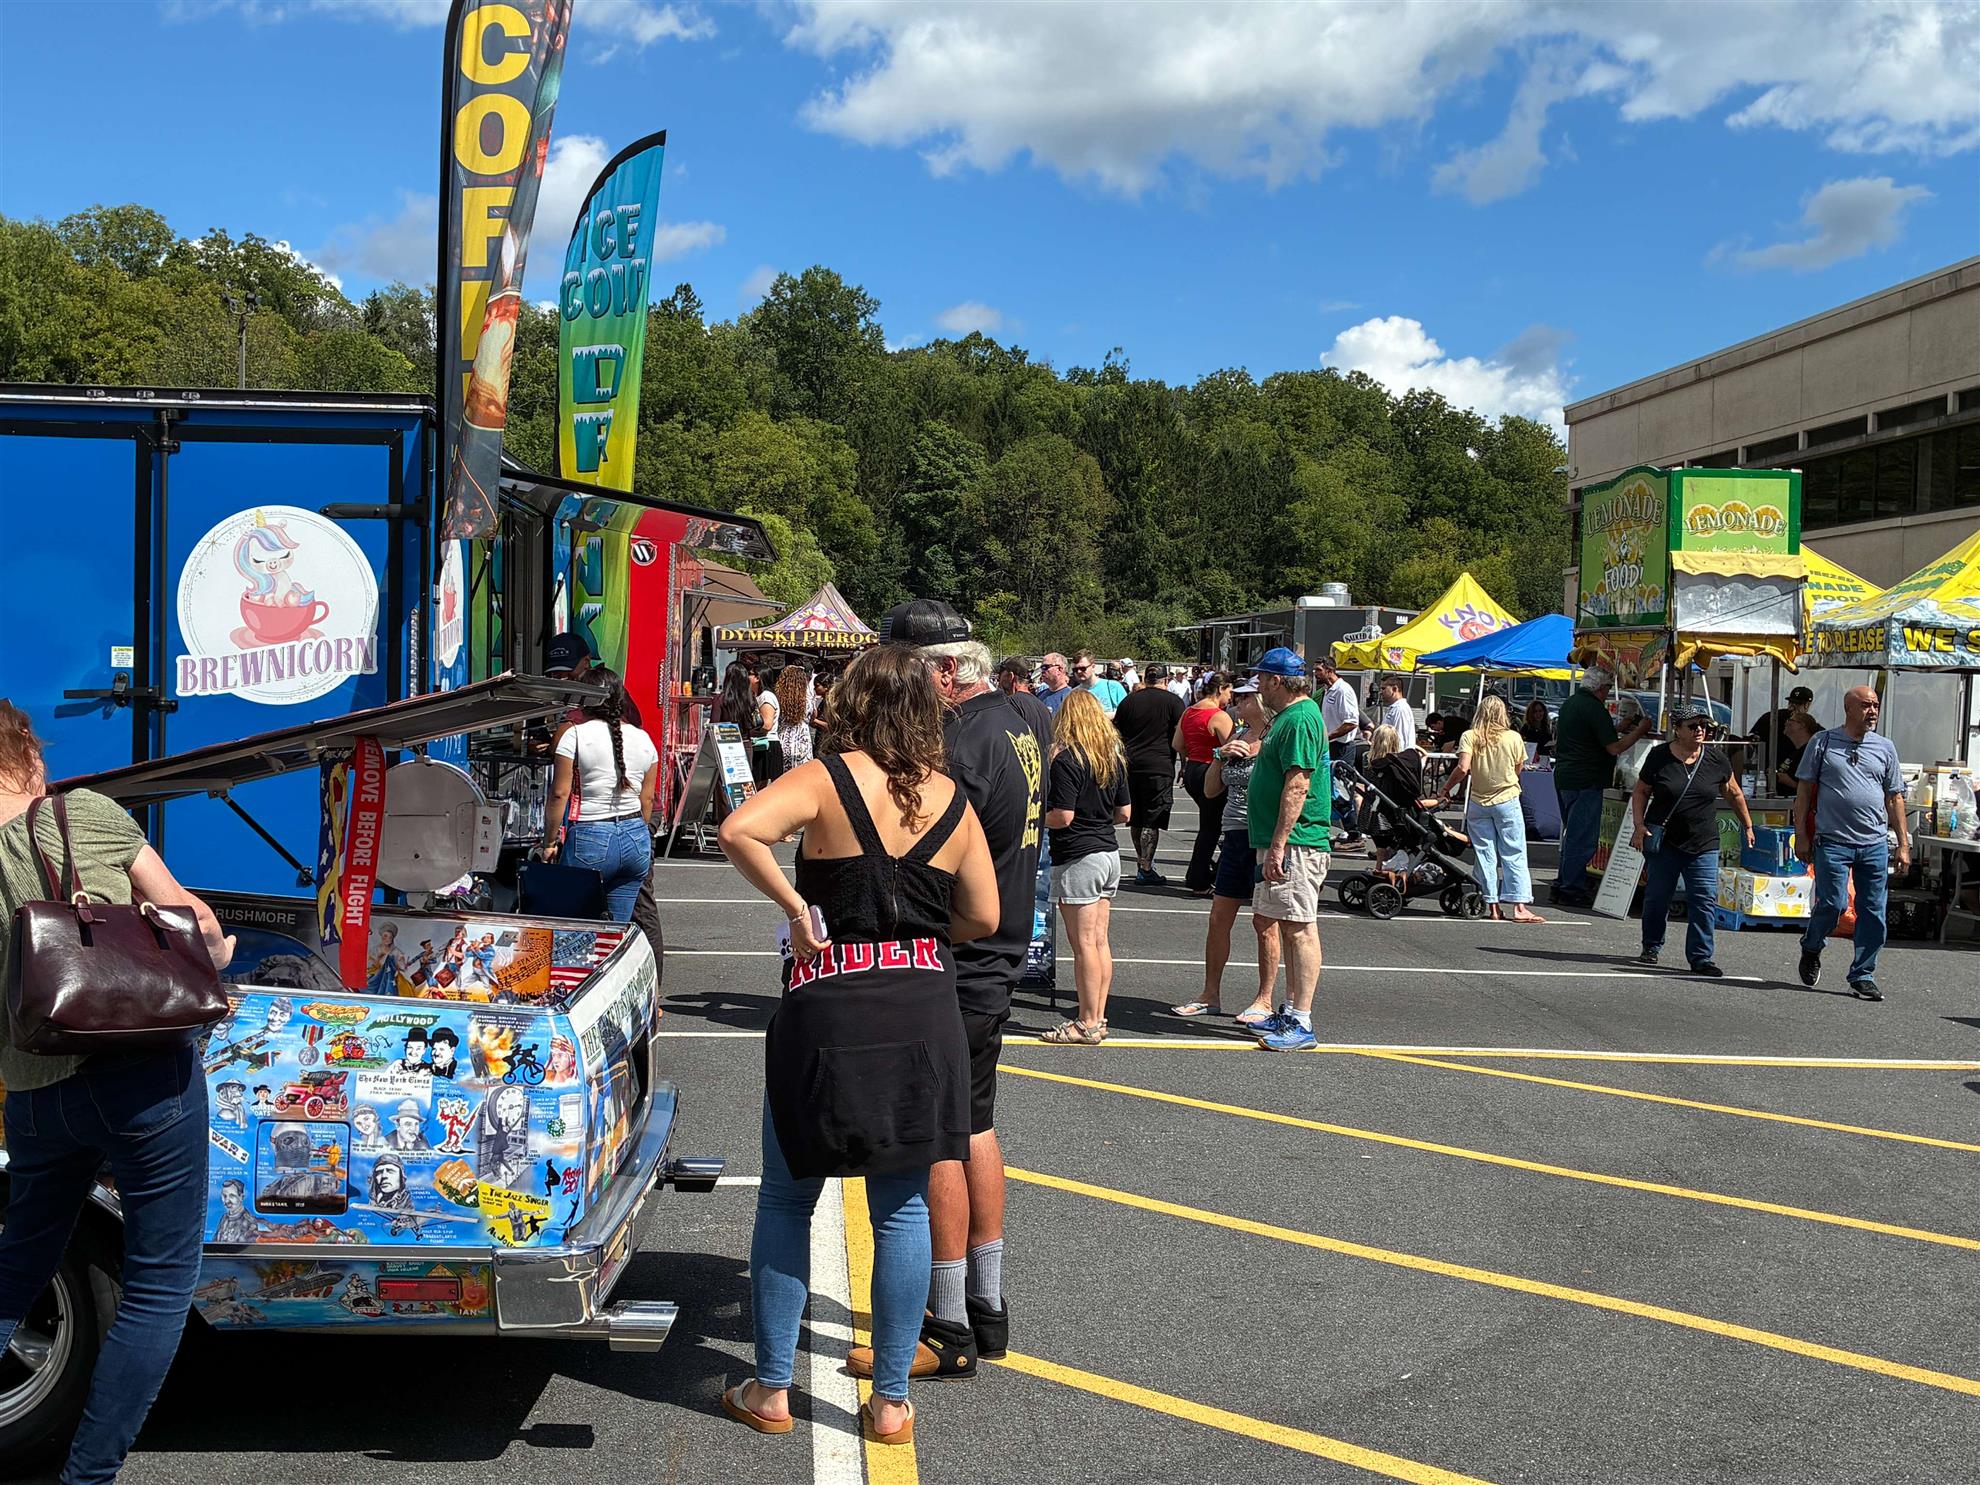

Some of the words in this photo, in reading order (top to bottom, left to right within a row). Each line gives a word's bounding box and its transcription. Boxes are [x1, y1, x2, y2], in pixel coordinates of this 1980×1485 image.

[579, 203, 642, 263] ICE
[1584, 494, 1665, 538] LEMONADE
[1685, 510, 1788, 537] LEMONADE
[1604, 566, 1645, 595] FOOD!
[1803, 581, 1866, 593] NADE
[1811, 593, 1862, 603] FOOD
[720, 629, 796, 642] DYMSKI
[803, 631, 879, 644] PIEROG
[1834, 627, 1885, 653] PLEASE
[1903, 627, 1957, 652] WE
[180, 637, 374, 692] BREWNICORN
[360, 736, 382, 803] REMOVE
[352, 811, 377, 867] BEFORE
[346, 874, 369, 927] FLIGHT
[215, 907, 297, 925] RUSHMORE
[376, 1014, 434, 1025] HOLLYWOOD
[211, 1131, 240, 1156] WAR
